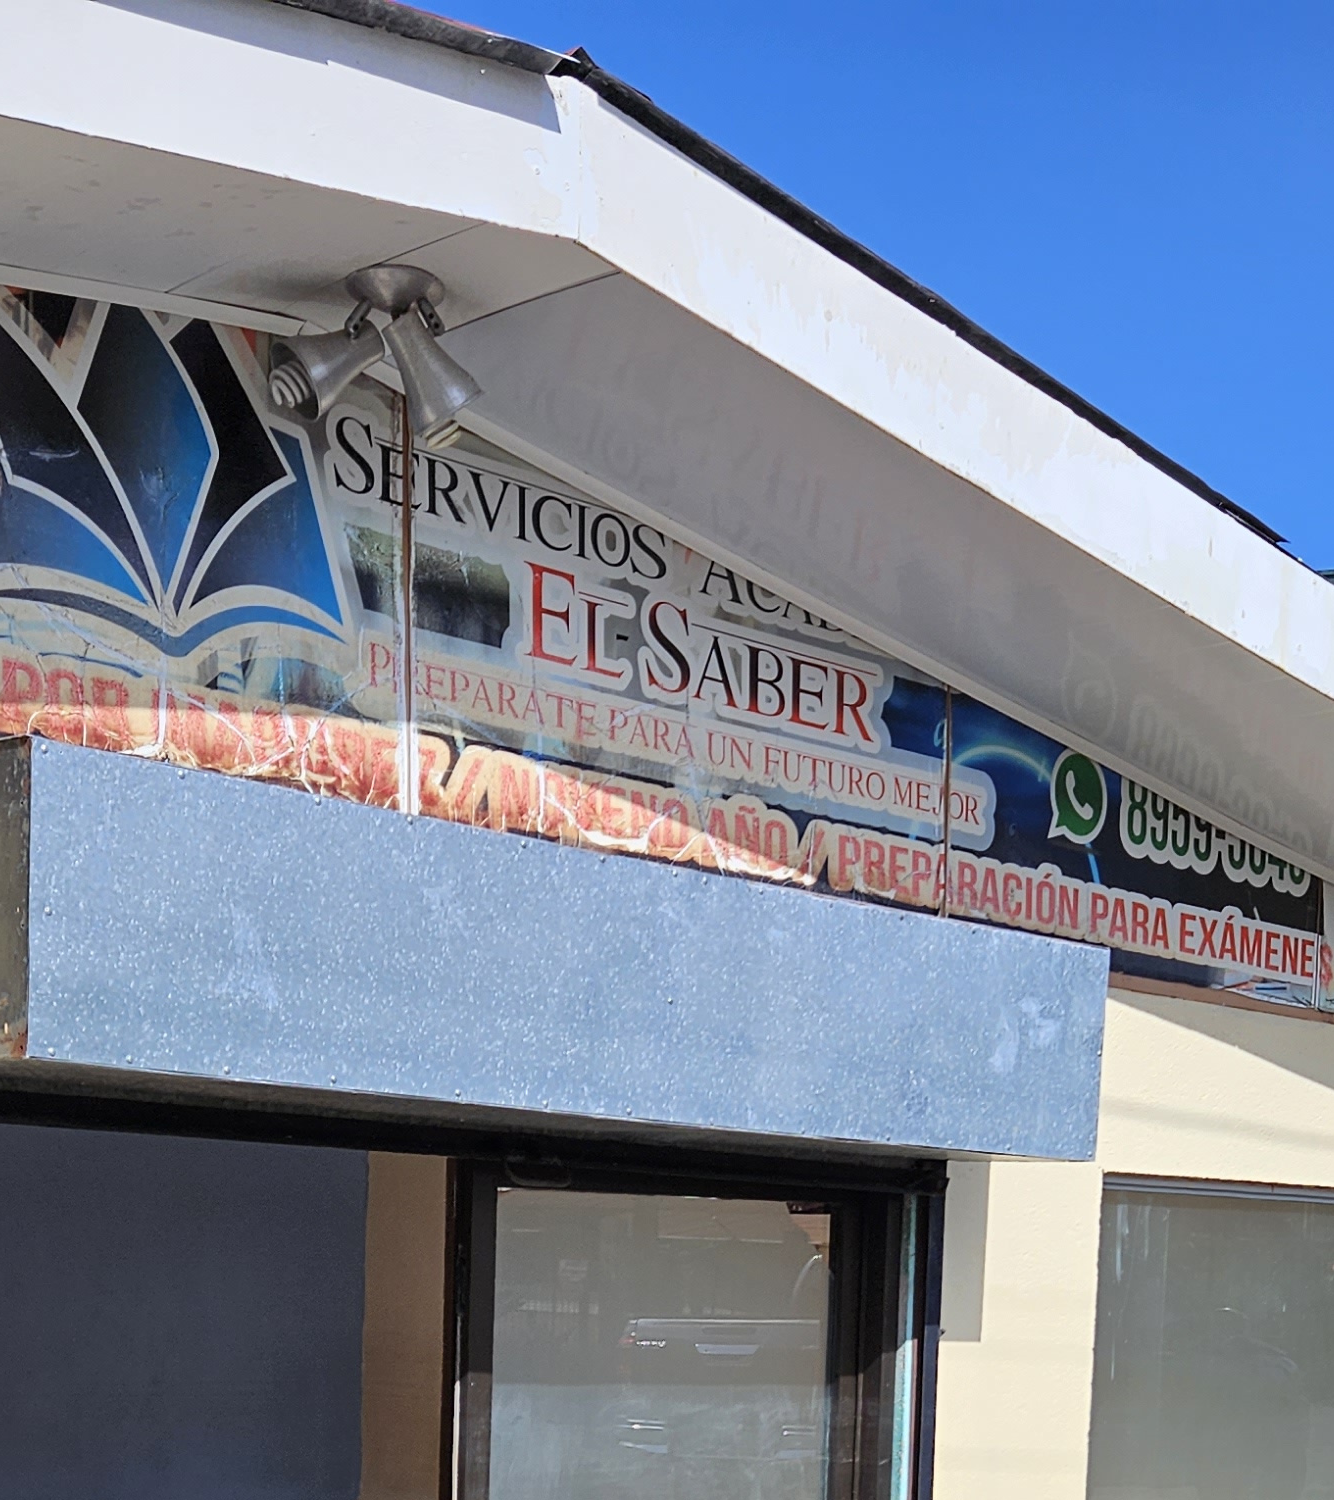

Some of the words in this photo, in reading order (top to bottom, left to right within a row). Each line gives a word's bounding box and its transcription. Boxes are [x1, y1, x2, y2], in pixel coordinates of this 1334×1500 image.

[333, 416, 667, 582] SERVICIOS
[525, 560, 629, 680] EL
[648, 600, 877, 743] SABER
[2, 657, 138, 750] POR
[706, 803, 788, 872] AÑO
[839, 835, 1079, 930] PREPARACIÓN
[1091, 892, 1170, 952] PARA
[1180, 913, 1334, 988] EXÁMENES
[609, 708, 695, 760] PARA
[707, 732, 752, 770] UN
[764, 748, 884, 803] FUTURO
[892, 780, 980, 827] MEJOR
